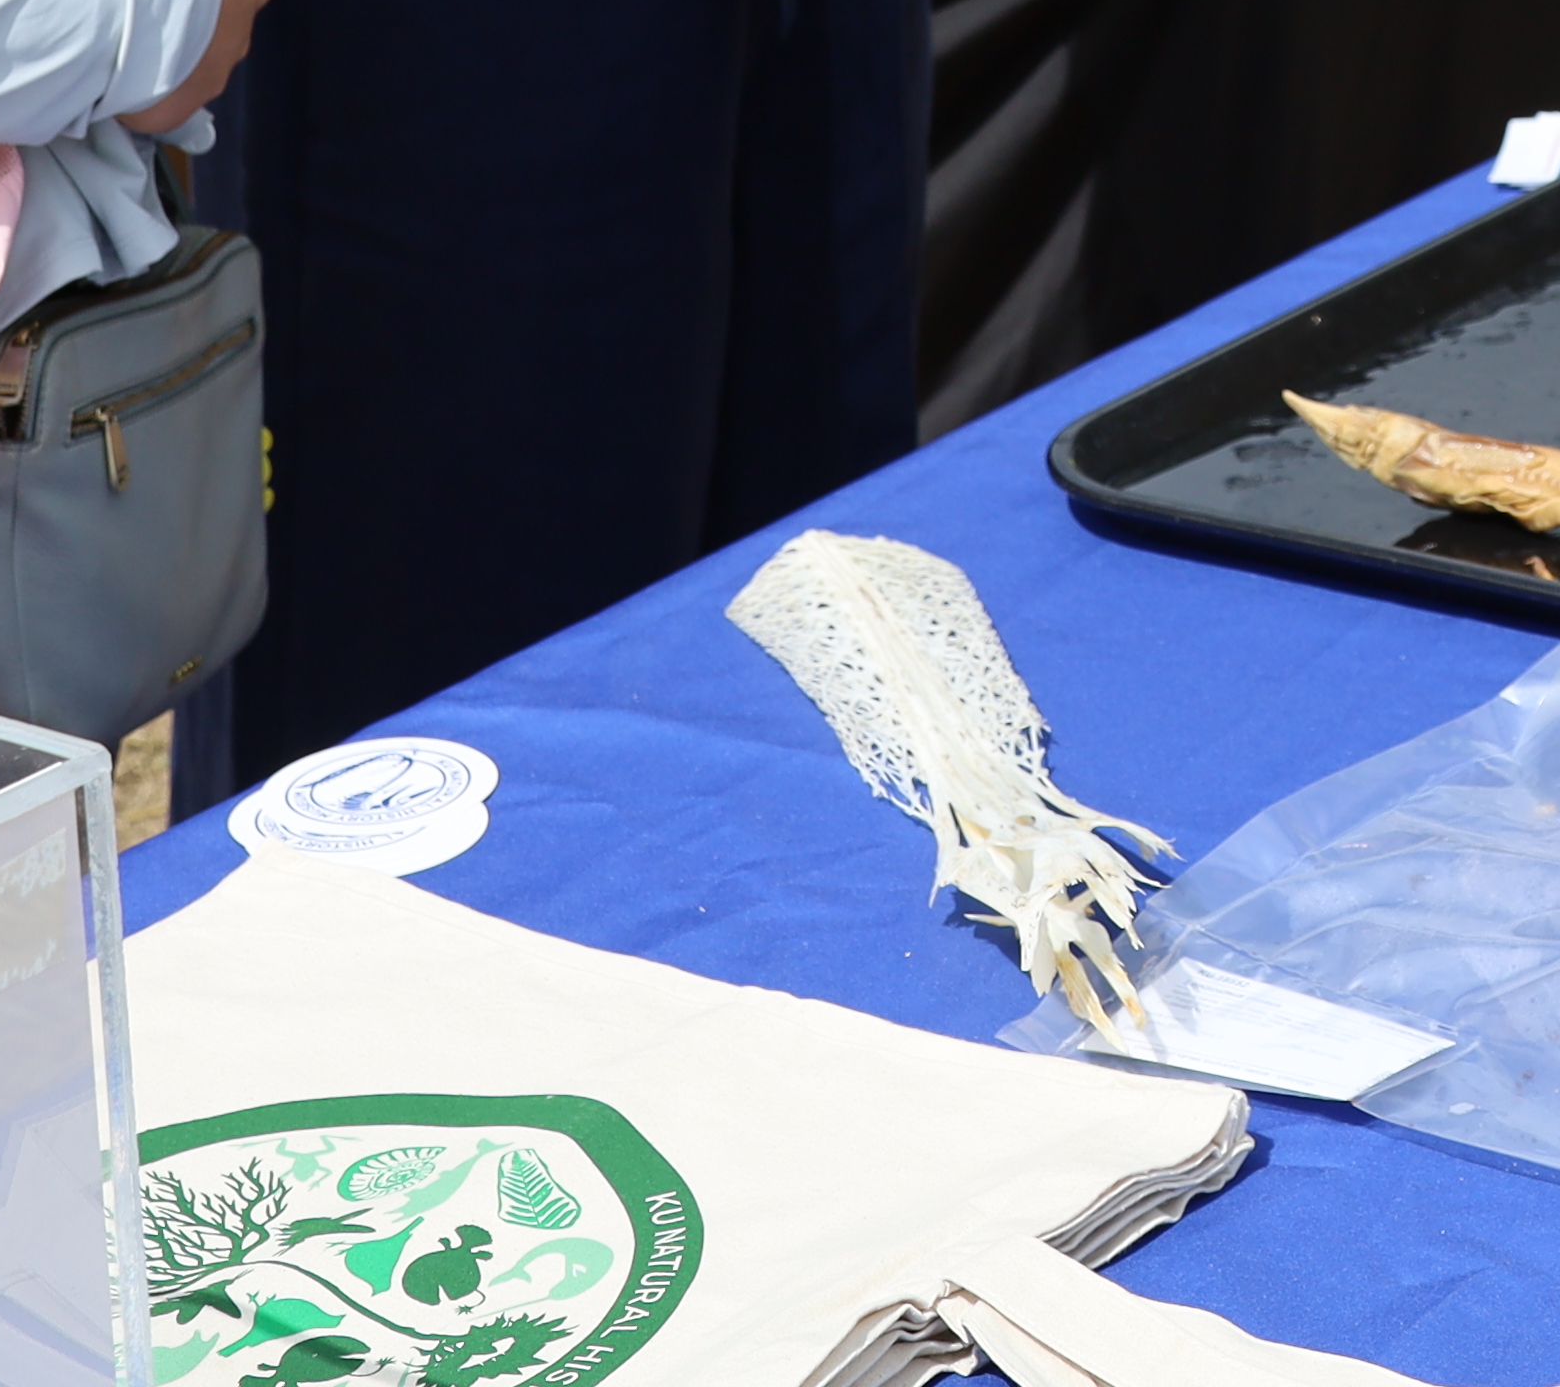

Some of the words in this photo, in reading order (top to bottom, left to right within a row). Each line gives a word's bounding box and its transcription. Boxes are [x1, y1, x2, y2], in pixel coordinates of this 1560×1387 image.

[337, 807, 417, 823] HISTORY
[644, 1190, 686, 1226] KU
[599, 1226, 687, 1339] NATURAL
[544, 1344, 615, 1386] HIS
